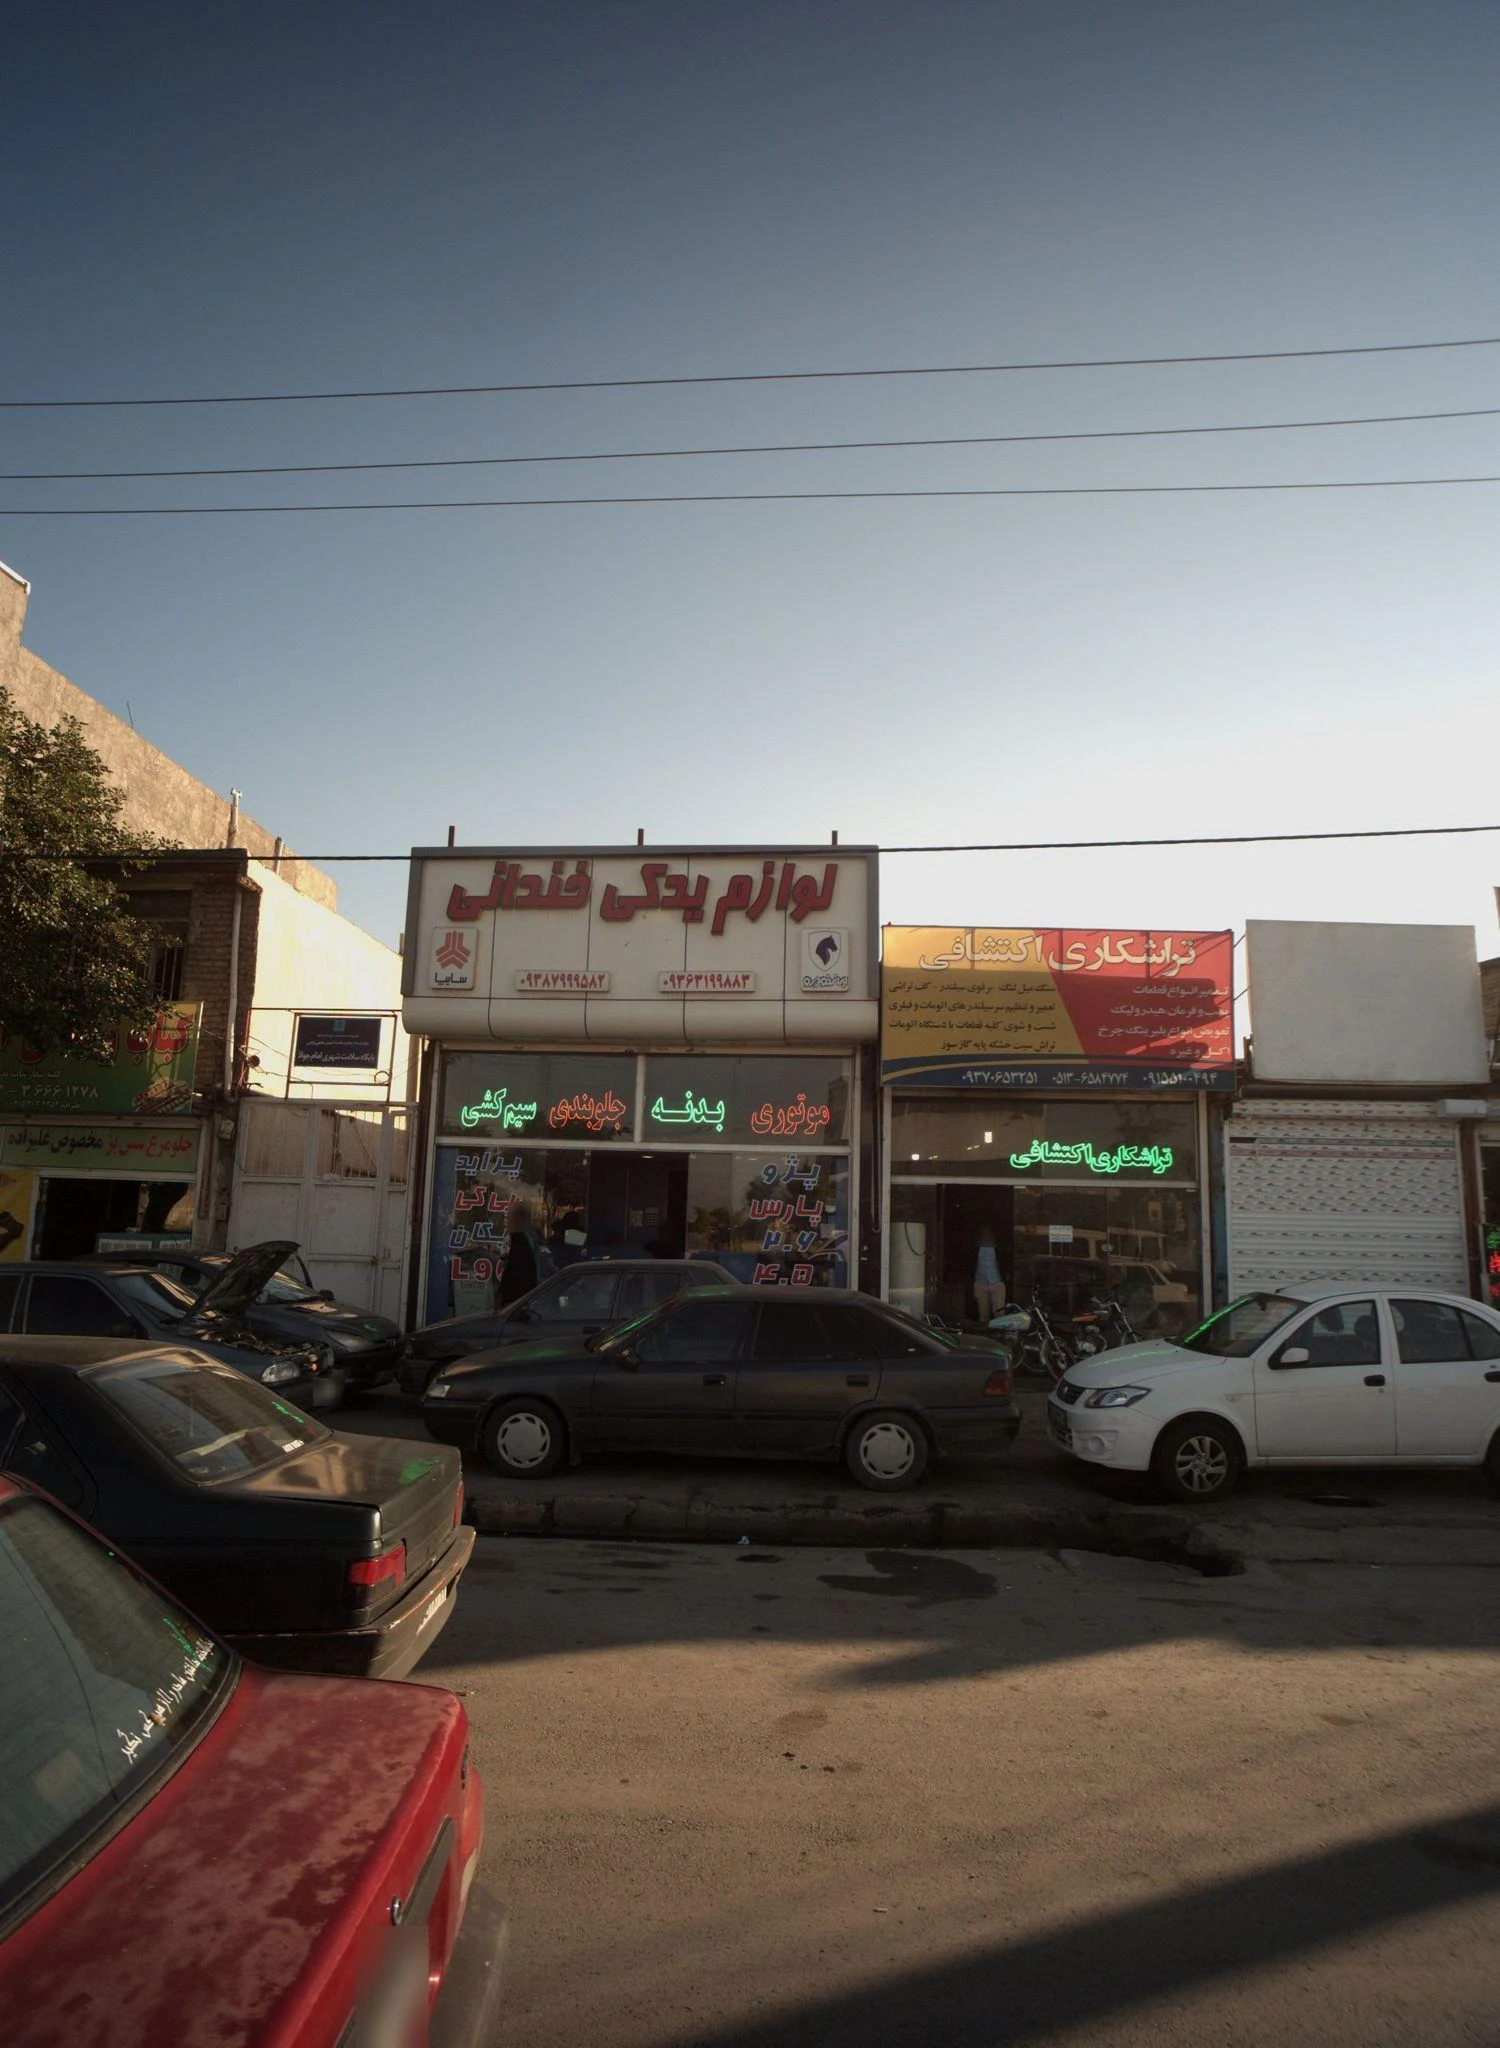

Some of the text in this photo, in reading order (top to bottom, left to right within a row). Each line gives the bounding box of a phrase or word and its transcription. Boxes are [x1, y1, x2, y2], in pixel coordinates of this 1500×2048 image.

[599, 863, 709, 922] یدکی
[711, 861, 839, 935] لوازم
[920, 934, 1196, 976] تراشکاری اکتشافی
[434, 972, 468, 986] سایپا
[663, 973, 750, 989] ۰۹۳۶۳۱۹۹۸۸۳
[1133, 985, 1229, 998] تعمیر انواع قطعات
[1168, 1005, 1197, 1018] فرمان
[461, 1088, 537, 1128] سیم کشی
[549, 1090, 626, 1131] جلوبندی
[652, 1090, 725, 1133] بدنه
[750, 1094, 830, 1134] موتوری
[455, 1152, 522, 1179] پراید
[763, 1155, 821, 1190] پژو
[1009, 1140, 1173, 1175] تراشکاری اکتشافی
[750, 1195, 824, 1226] پارس
[763, 1230, 817, 1253] ۲۰۶
[753, 1263, 814, 1285] ۴۰۵
